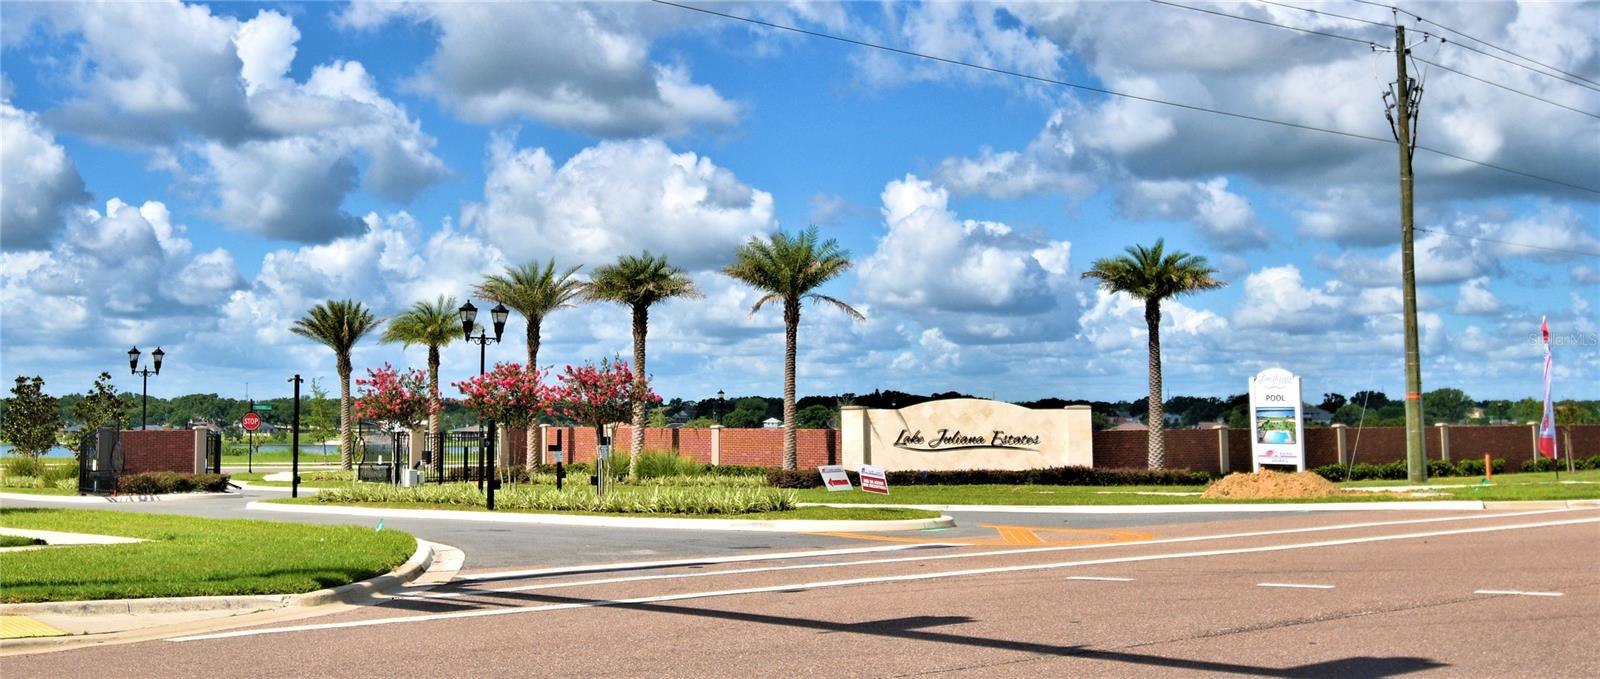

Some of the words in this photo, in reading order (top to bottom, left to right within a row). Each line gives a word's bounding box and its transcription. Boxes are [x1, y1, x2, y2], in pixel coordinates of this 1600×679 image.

[244, 417, 259, 425] STOP
[893, 429, 925, 447] Lake
[928, 428, 986, 448] Juliana
[990, 430, 1041, 447] Estates
